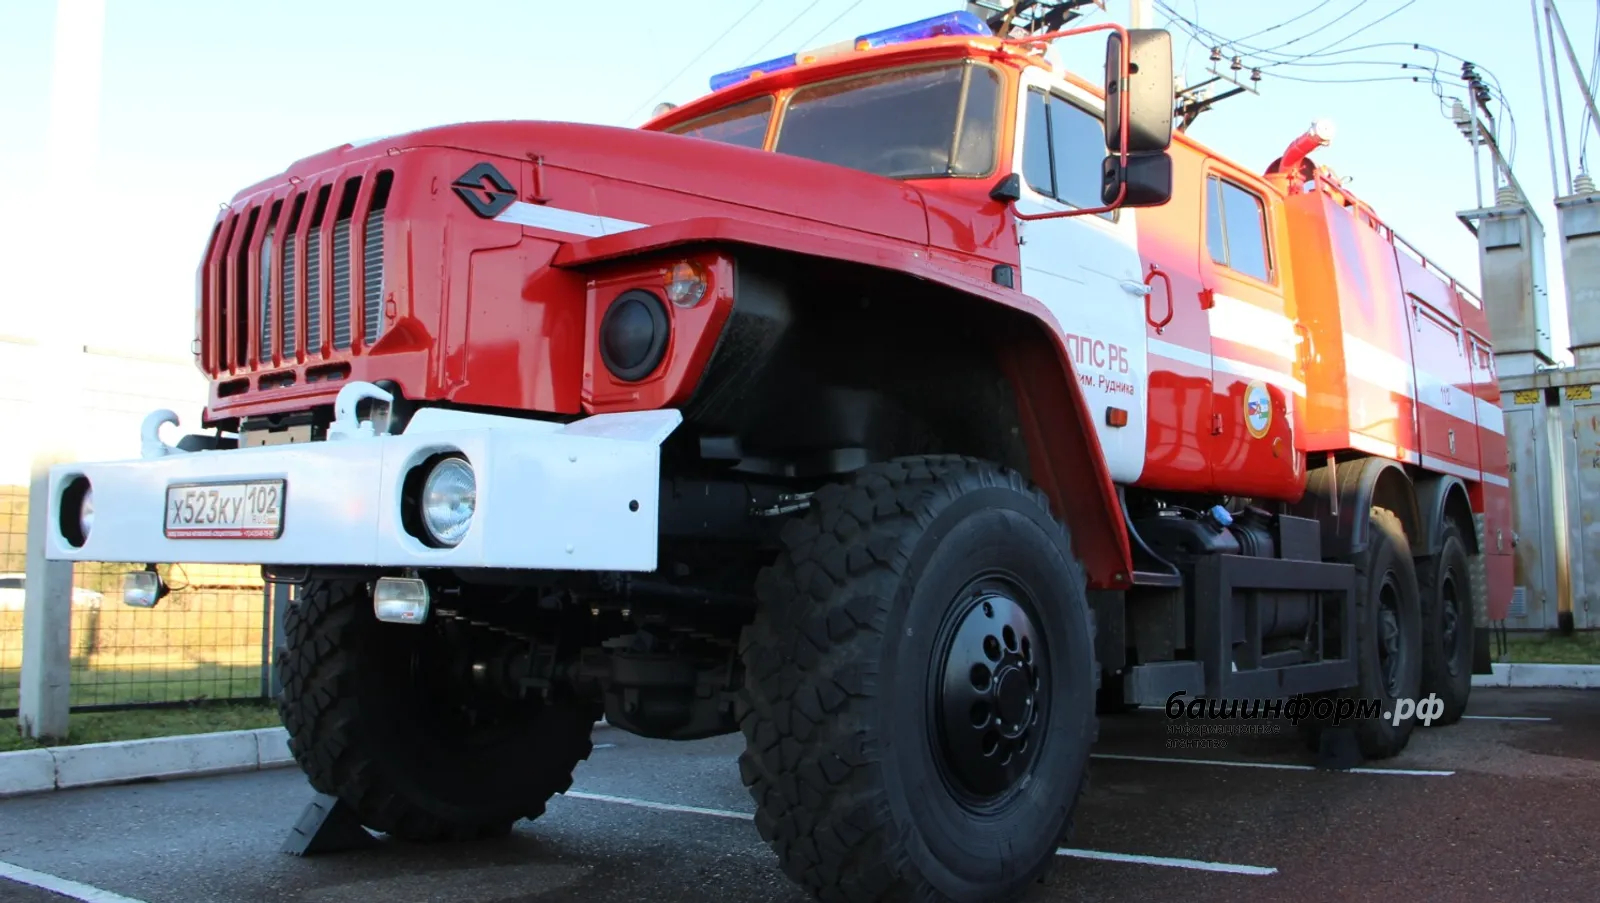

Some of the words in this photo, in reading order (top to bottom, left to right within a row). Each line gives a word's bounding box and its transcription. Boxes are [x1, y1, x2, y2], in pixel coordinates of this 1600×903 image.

[1108, 343, 1129, 374] РБ
[1098, 374, 1135, 396] Рудника
[248, 486, 277, 514] 102
